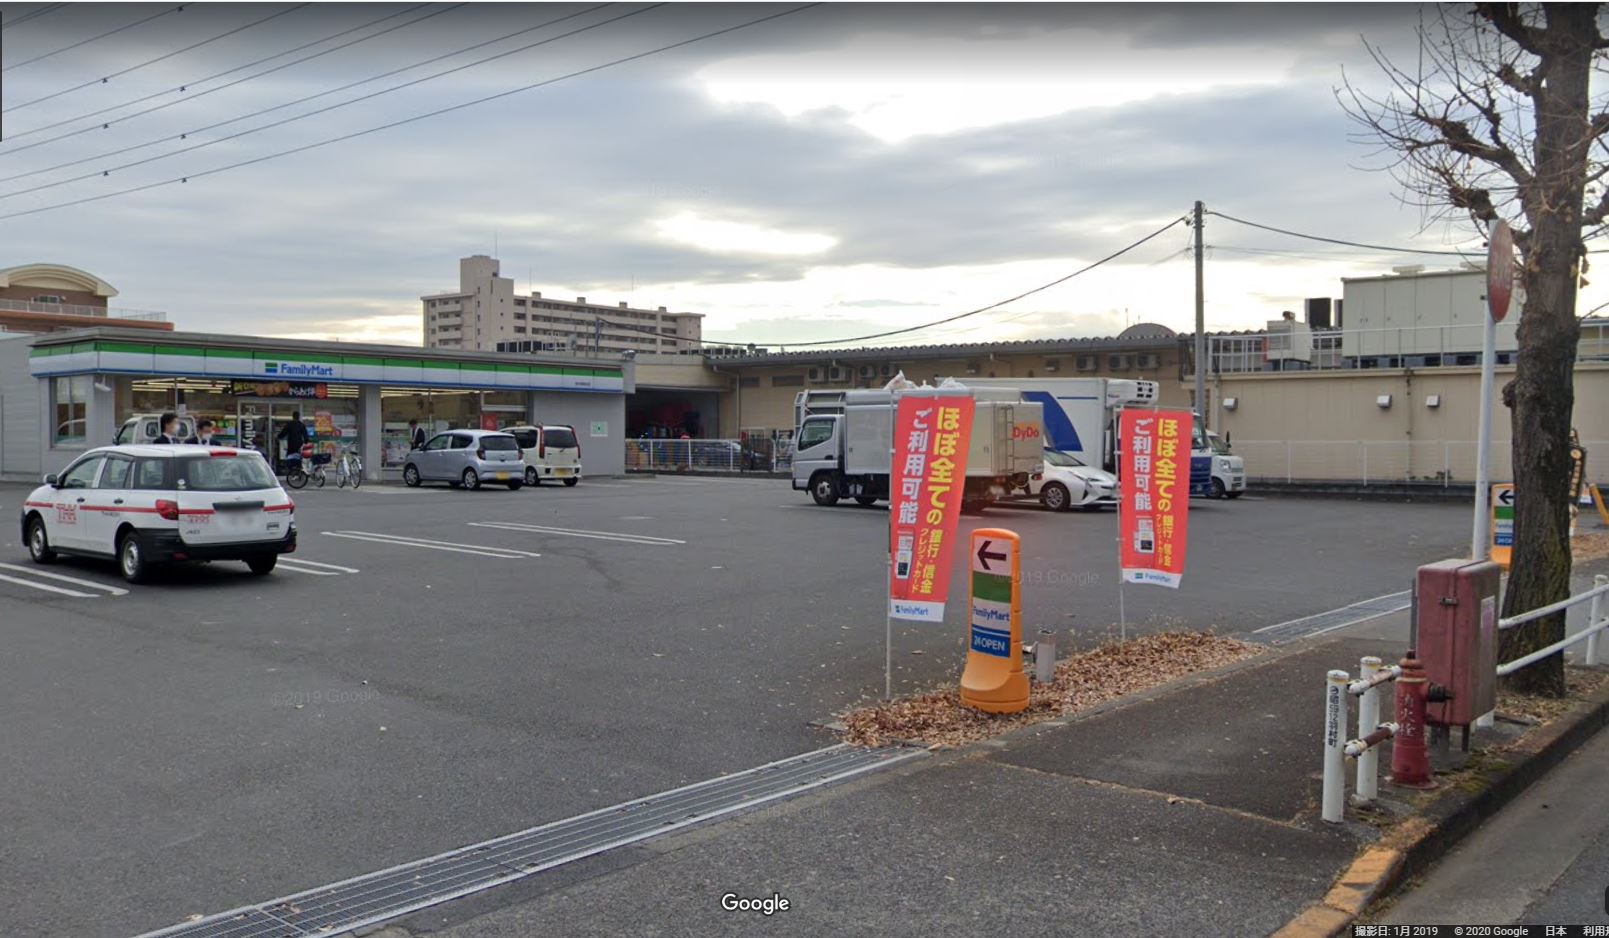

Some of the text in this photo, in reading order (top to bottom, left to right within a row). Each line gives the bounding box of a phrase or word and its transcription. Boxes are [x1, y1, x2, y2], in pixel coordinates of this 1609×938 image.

[281, 363, 333, 376] FamilyMart
[1012, 426, 1039, 441] DyDo
[898, 407, 932, 525] ご利用可能
[1132, 417, 1154, 511] ご利用可能
[900, 605, 929, 616] FamilyMart
[972, 606, 1010, 621] FamilyMart
